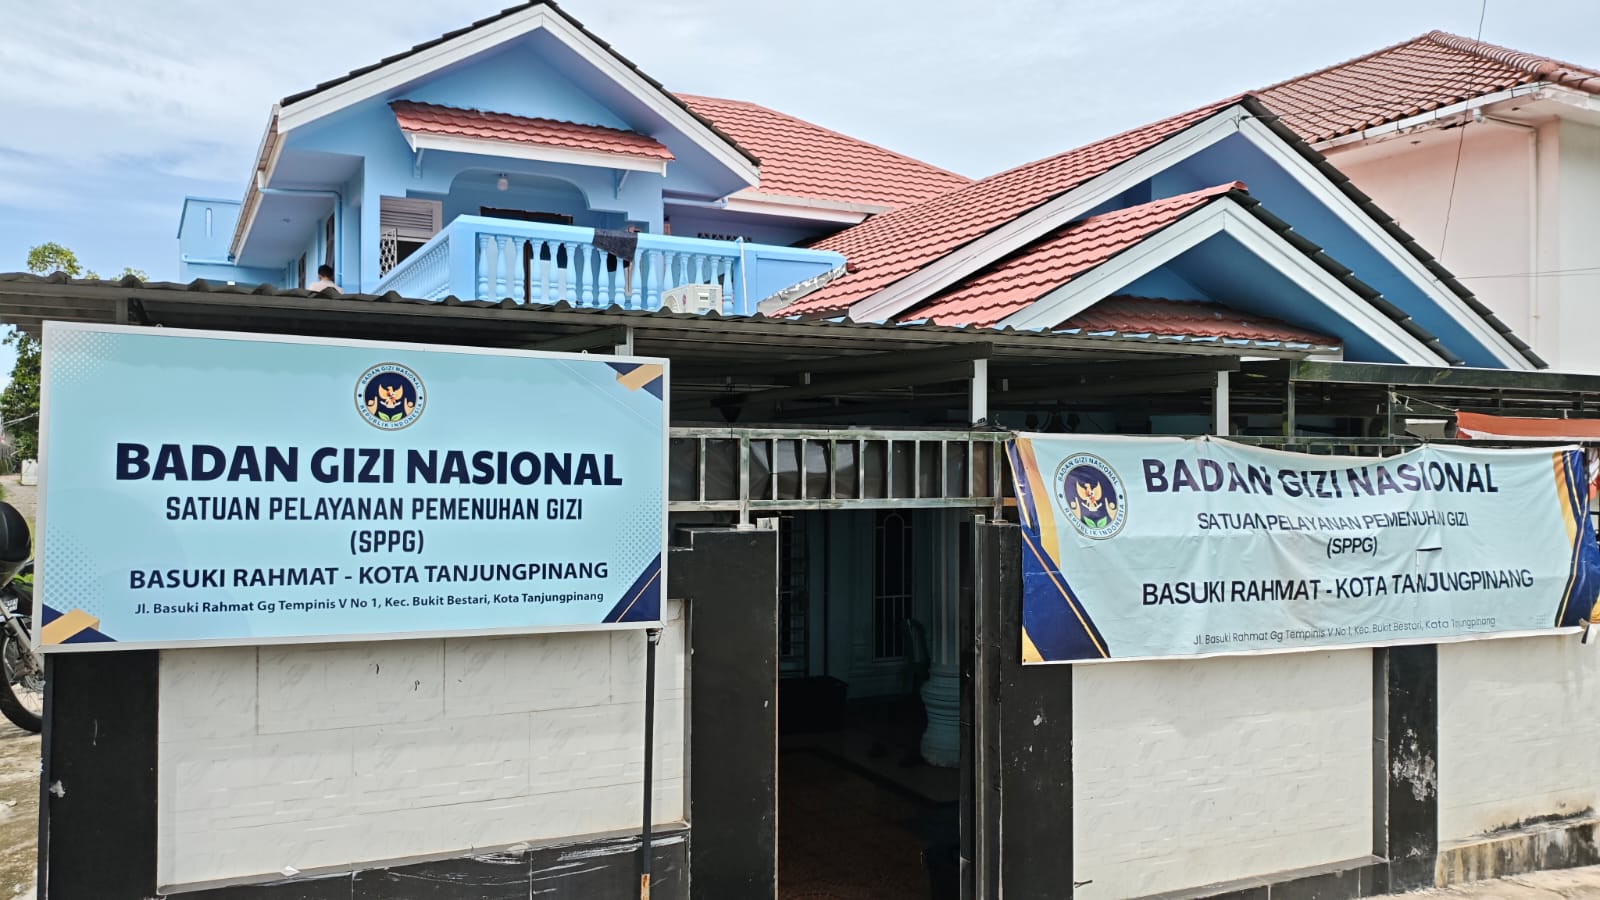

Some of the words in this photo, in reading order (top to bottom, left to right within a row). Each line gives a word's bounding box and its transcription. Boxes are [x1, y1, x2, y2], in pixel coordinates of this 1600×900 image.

[116, 442, 299, 483] BADAN
[310, 446, 395, 484] GIZI
[406, 448, 623, 486] NASIONAL
[1142, 459, 1273, 496] BADAN
[1278, 469, 1343, 498] GIZI
[1346, 461, 1499, 498] NASIONAL
[166, 496, 260, 521] SATUAN
[269, 496, 403, 521] PELAYANAN
[411, 497, 539, 521] PEMENUHAN
[546, 498, 583, 520] GIZI
[1197, 512, 1267, 530] SATUAN
[1266, 514, 1361, 531] PELAYANAN
[1446, 511, 1469, 527] GIZI
[350, 529, 424, 555] (SPPG)
[1327, 535, 1378, 559] (SPPG)
[130, 568, 225, 589] BASUKI
[233, 566, 339, 588] RAHMAT
[358, 565, 420, 585] KOTA
[424, 562, 608, 584] TANJUNGPINANG
[1142, 581, 1225, 606] BASUKI
[1231, 579, 1321, 602] RAHMAT
[1336, 576, 1387, 599] KOTA
[1392, 569, 1534, 595] TANJUNGPINANG
[135, 603, 150, 615] Jl.
[153, 602, 199, 614] Basuki
[202, 601, 254, 613] Rahmat
[257, 600, 276, 613] Gg
[278, 599, 336, 612] Tempinis
[338, 598, 348, 609] V
[350, 598, 368, 609] No
[371, 598, 382, 609] 1,
[385, 596, 410, 607] Kec.
[413, 595, 445, 606] Bukit
[447, 594, 491, 606] Bestari,
[493, 593, 520, 604] Kota
[522, 591, 605, 604] Tanjungpinang
[1205, 633, 1231, 644] Basuki
[1233, 631, 1268, 643] Rahmat
[1270, 630, 1283, 643] Gg
[1286, 628, 1326, 640] Tempinis
[1327, 628, 1335, 637] V
[1336, 628, 1347, 637] No
[1372, 622, 1391, 633] Bukit
